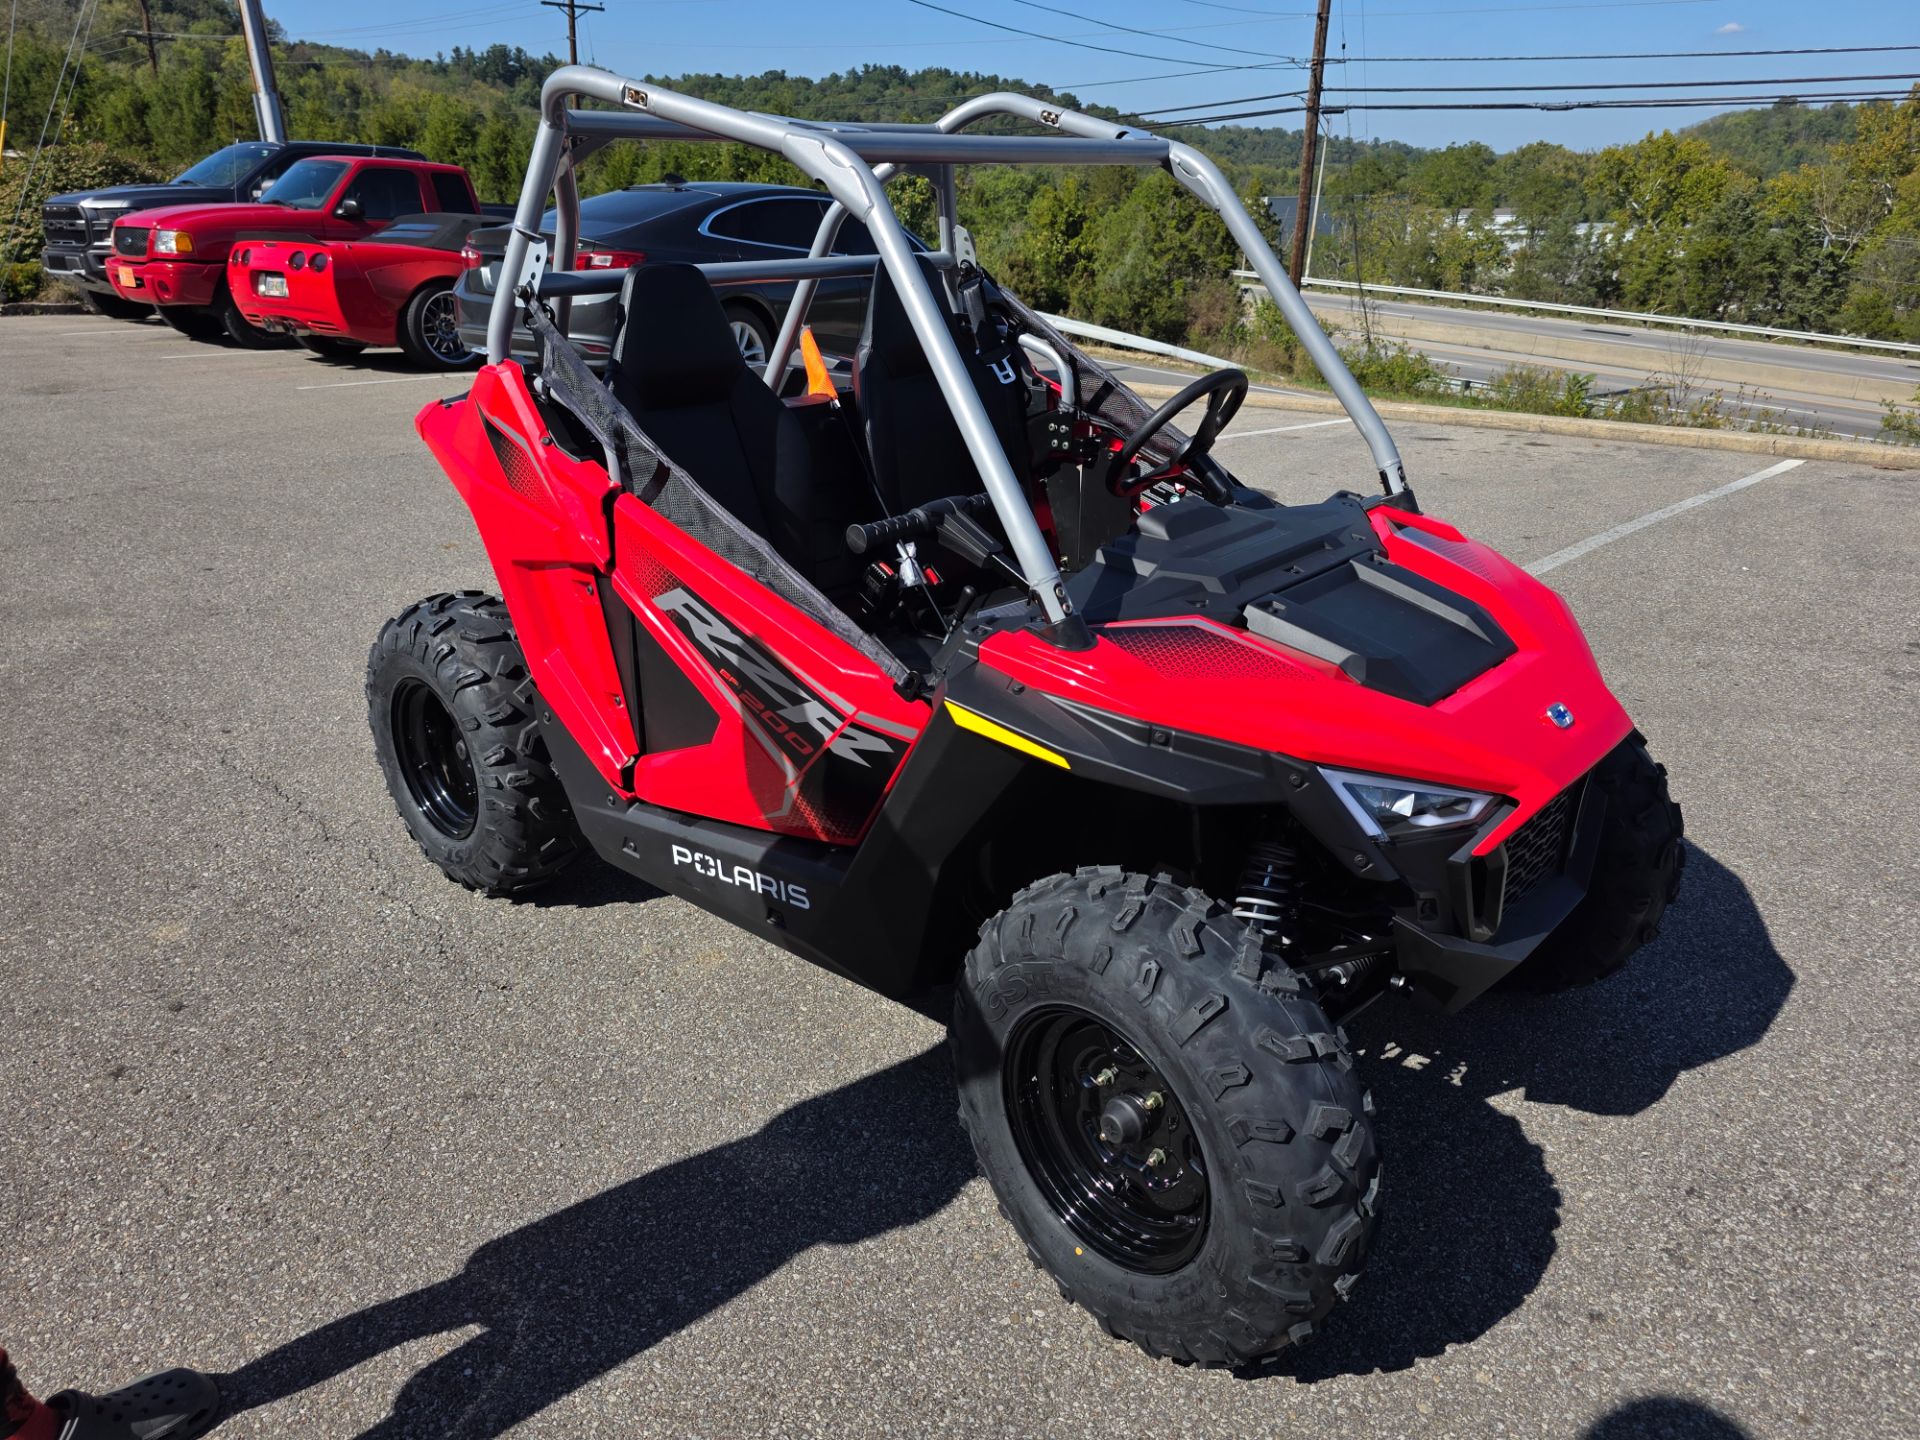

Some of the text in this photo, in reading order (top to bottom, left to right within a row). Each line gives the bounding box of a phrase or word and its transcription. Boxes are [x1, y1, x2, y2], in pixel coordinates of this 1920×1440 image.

[652, 587, 895, 768] RZR
[739, 690, 814, 755] 200
[671, 844, 810, 910] POLARIS
